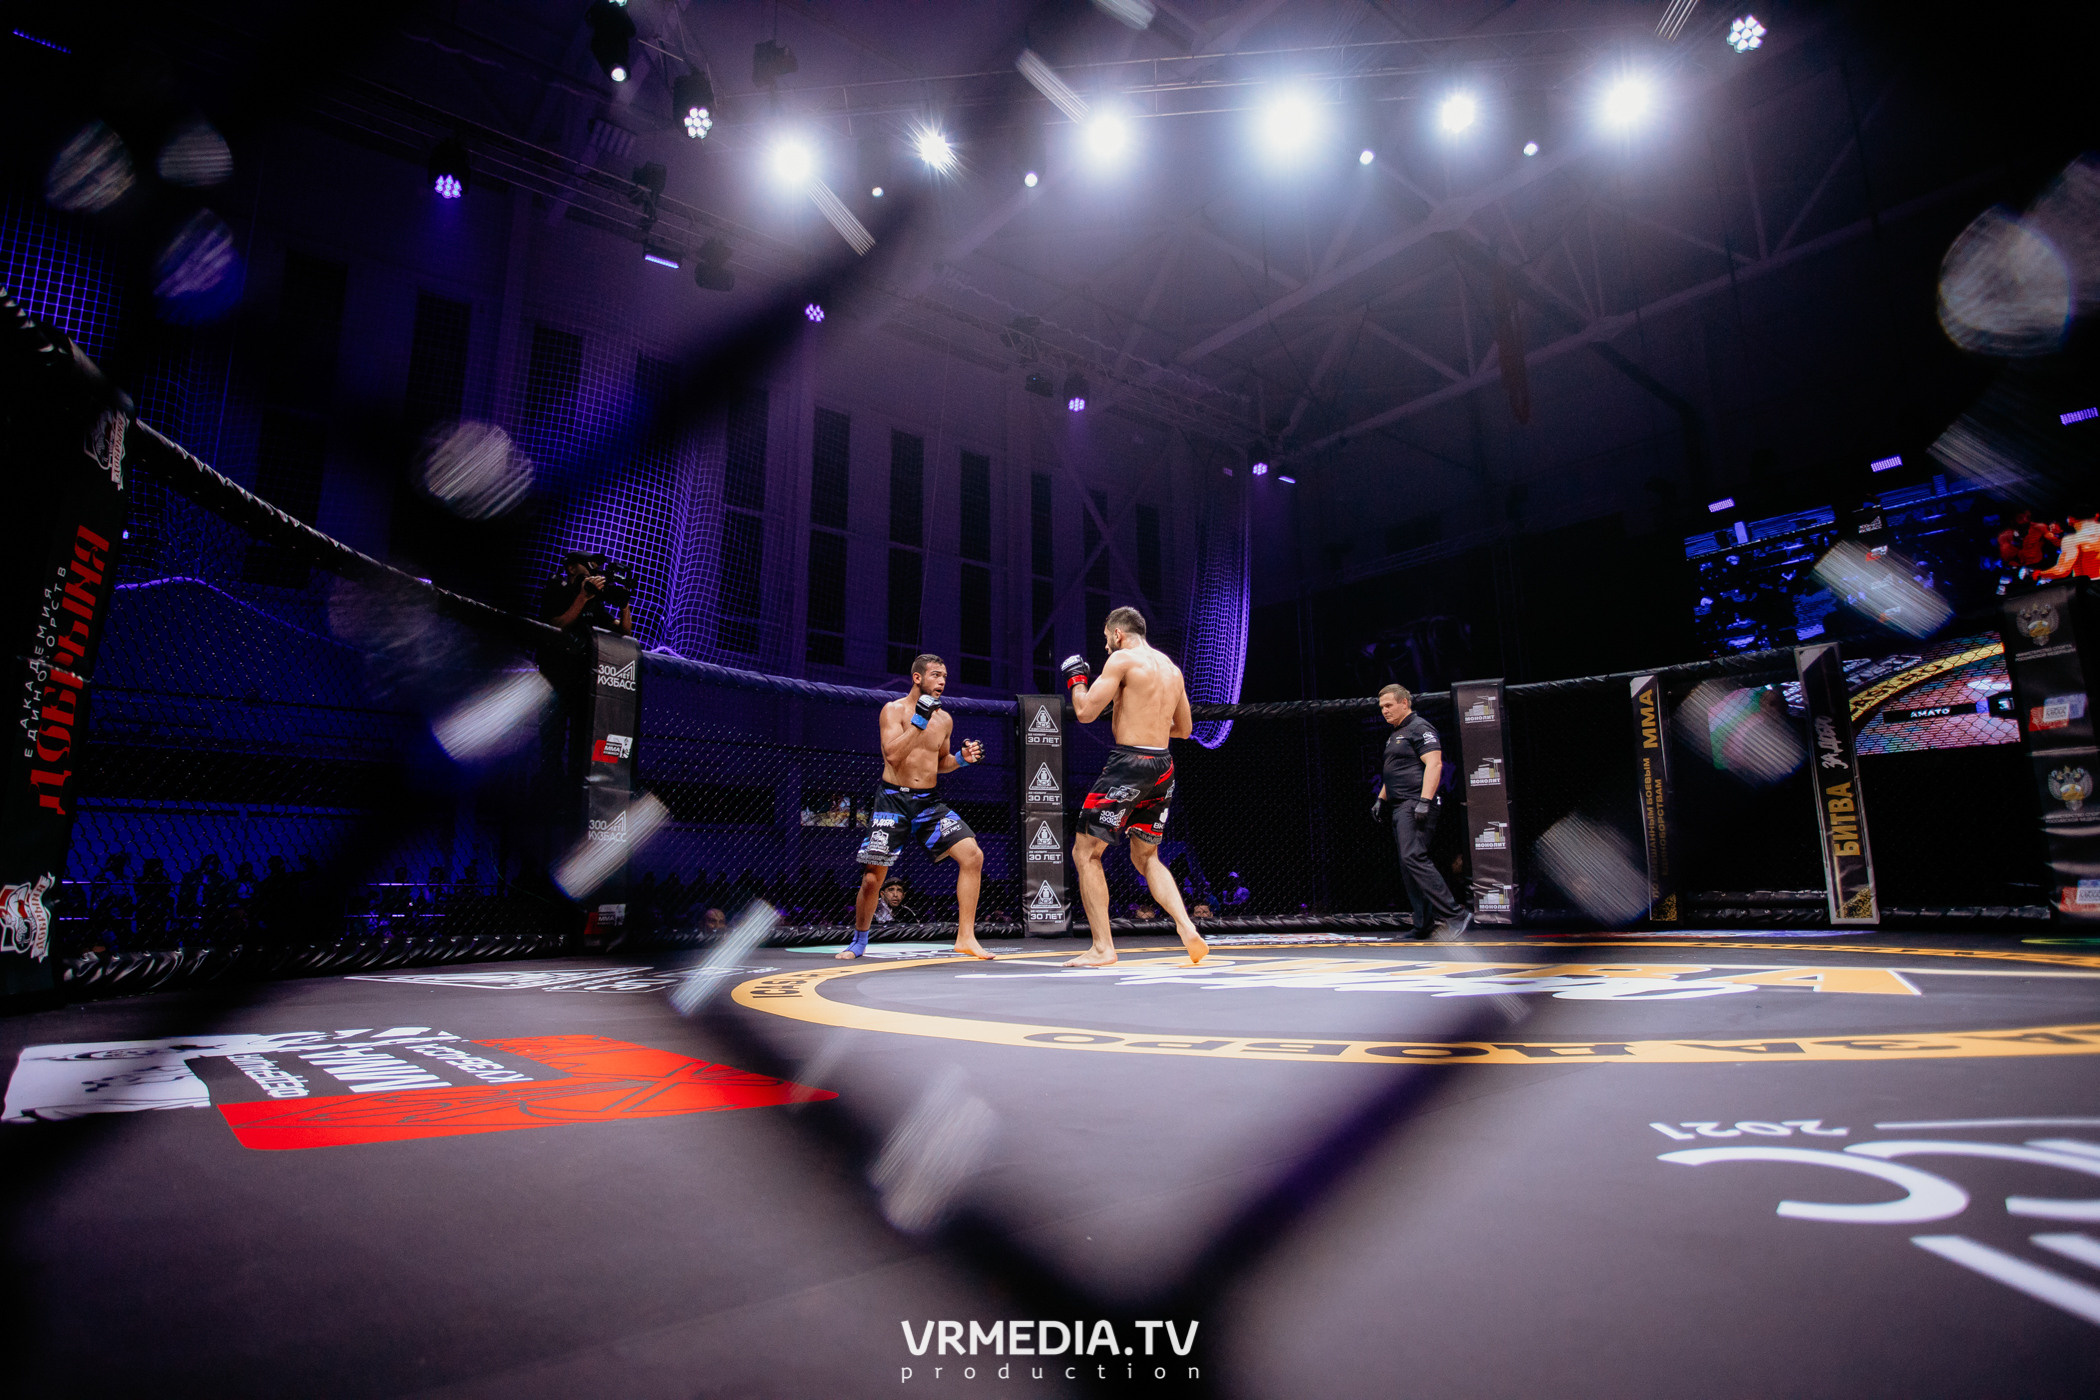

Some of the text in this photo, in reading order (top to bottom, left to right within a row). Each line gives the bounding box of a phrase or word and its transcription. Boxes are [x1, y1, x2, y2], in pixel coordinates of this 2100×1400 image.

[20, 588, 52, 728] АКАДЕМИЯ
[28, 525, 109, 815] ДОБРЫНЯ
[598, 664, 617, 677] 300
[597, 675, 636, 691] КУЗБАСС
[1639, 689, 1658, 749] ММА
[1643, 757, 1653, 805] БОЕВЫМ
[588, 831, 627, 842] КУЗБАСС
[1826, 782, 1860, 856] БИТВА
[405, 1043, 533, 1084] КУЗБАССА
[1022, 1033, 1633, 1058] ДОБРО
[298, 1047, 452, 1093] ММА
[1649, 1120, 1849, 1140] 2021
